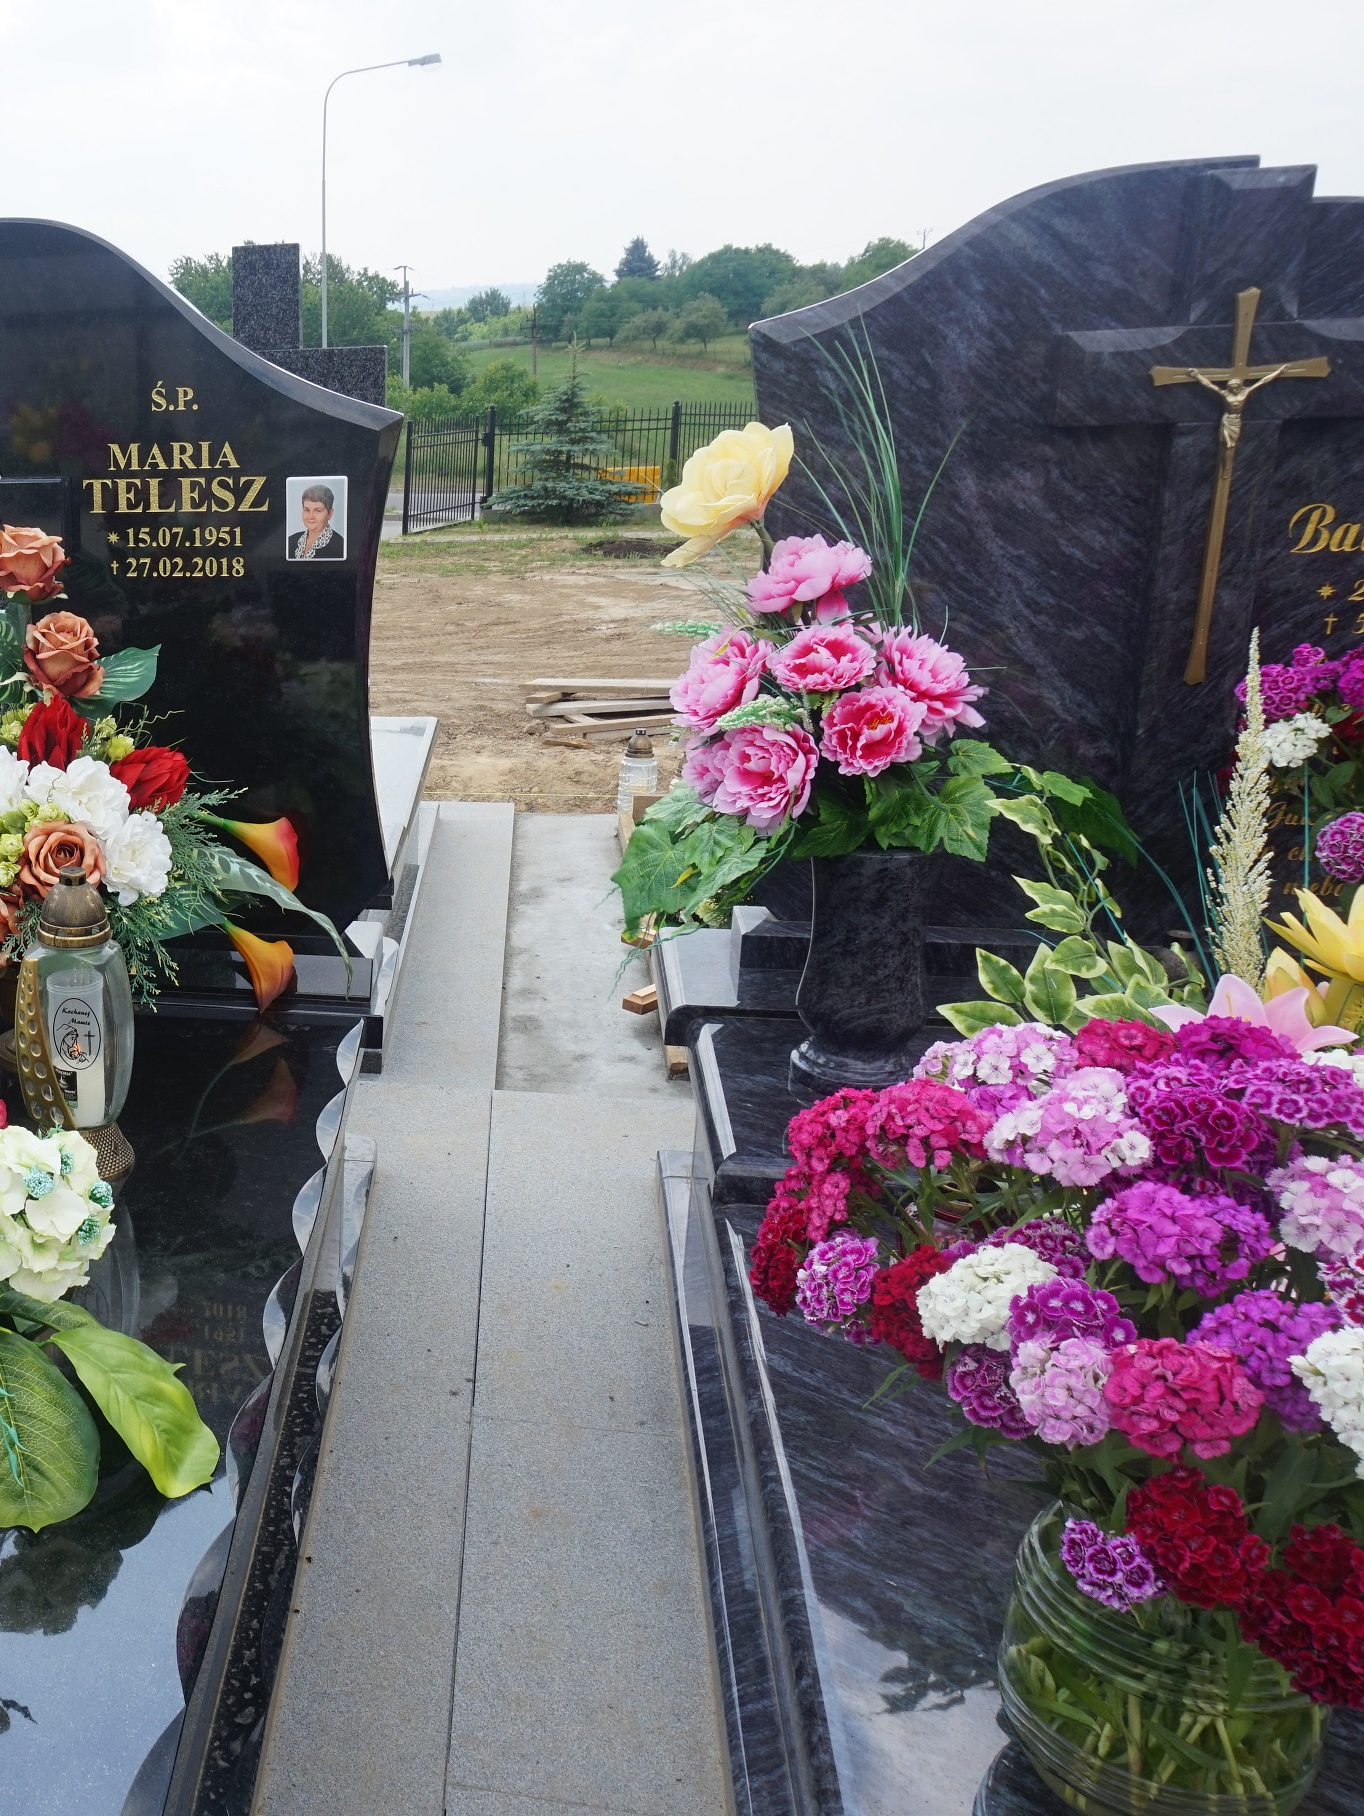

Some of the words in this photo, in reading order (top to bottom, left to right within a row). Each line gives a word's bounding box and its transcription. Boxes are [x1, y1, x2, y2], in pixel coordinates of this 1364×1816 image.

[152, 381, 198, 411] Ś.P.
[108, 441, 240, 470] MARIA
[83, 477, 269, 513] TELESZ
[126, 527, 242, 547] 15.07.1951
[1289, 504, 1364, 553] Ba
[126, 557, 244, 577] 27.02.2018
